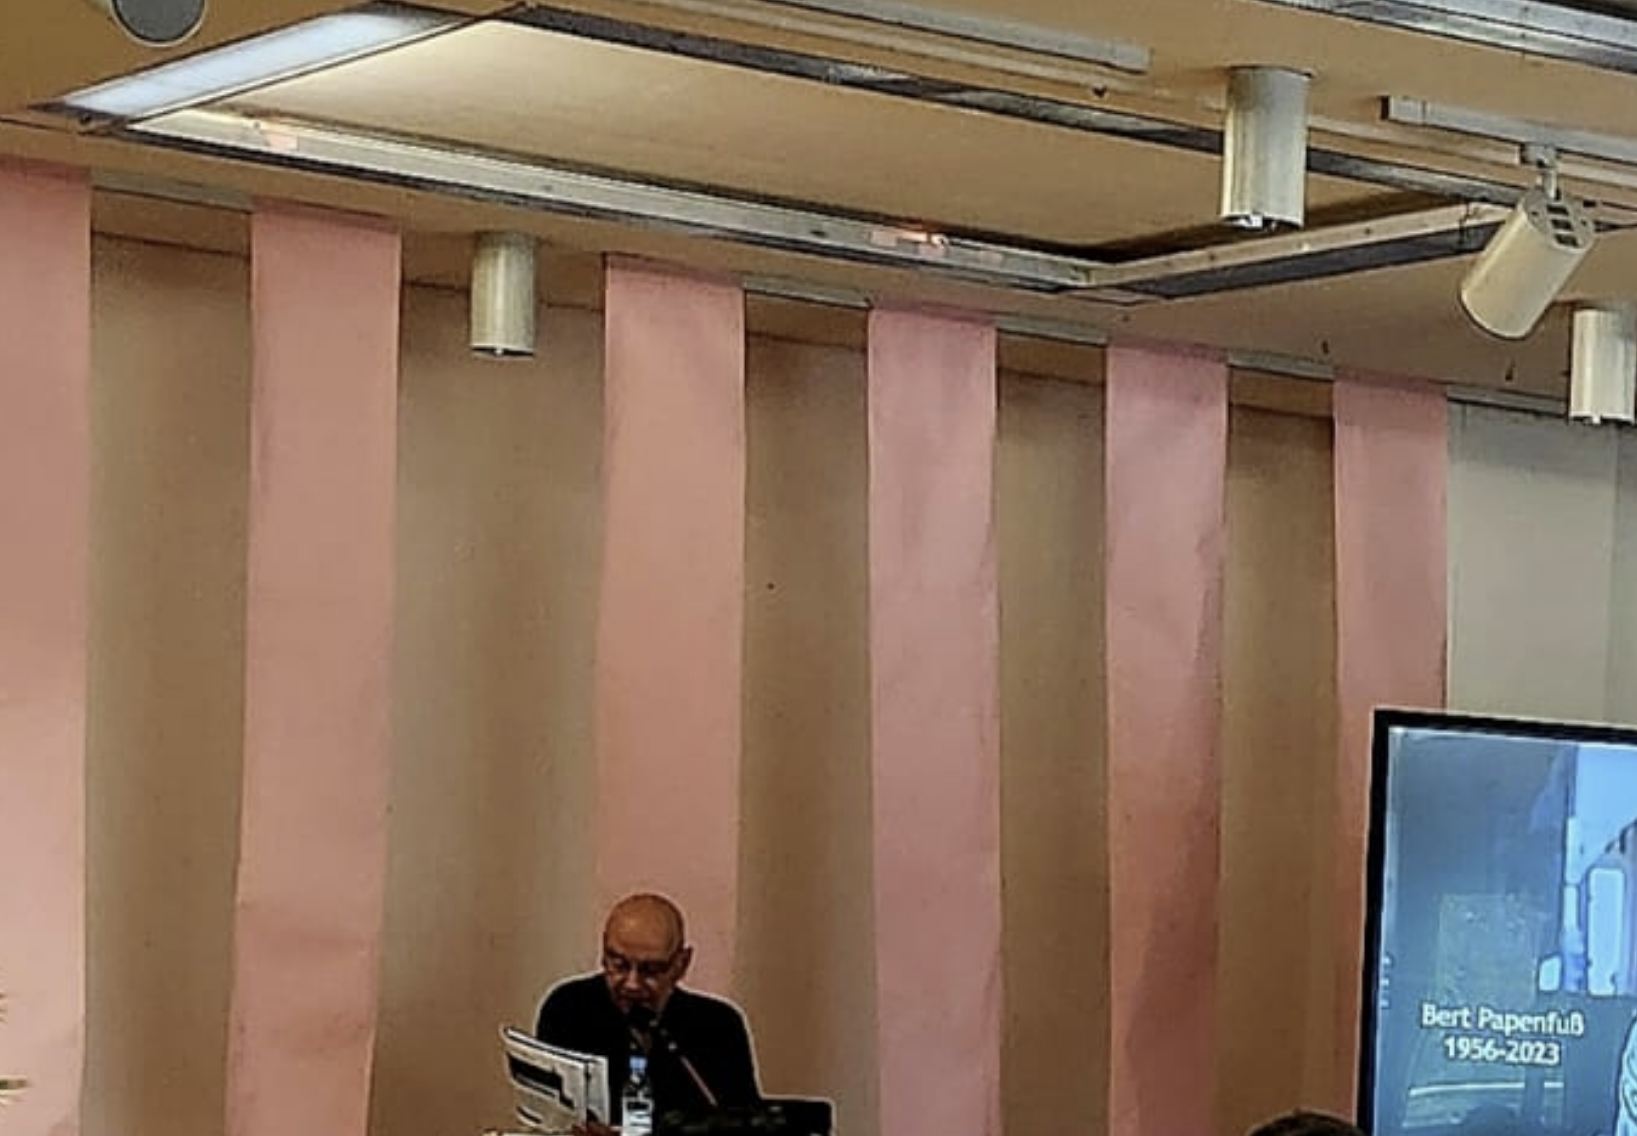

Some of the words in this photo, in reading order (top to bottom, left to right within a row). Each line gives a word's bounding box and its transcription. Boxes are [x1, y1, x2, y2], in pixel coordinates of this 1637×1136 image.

[1421, 1003, 1471, 1029] Bert
[1478, 1005, 1584, 1037] Papenfuß
[1444, 1036, 1560, 1065] 1956-2023
